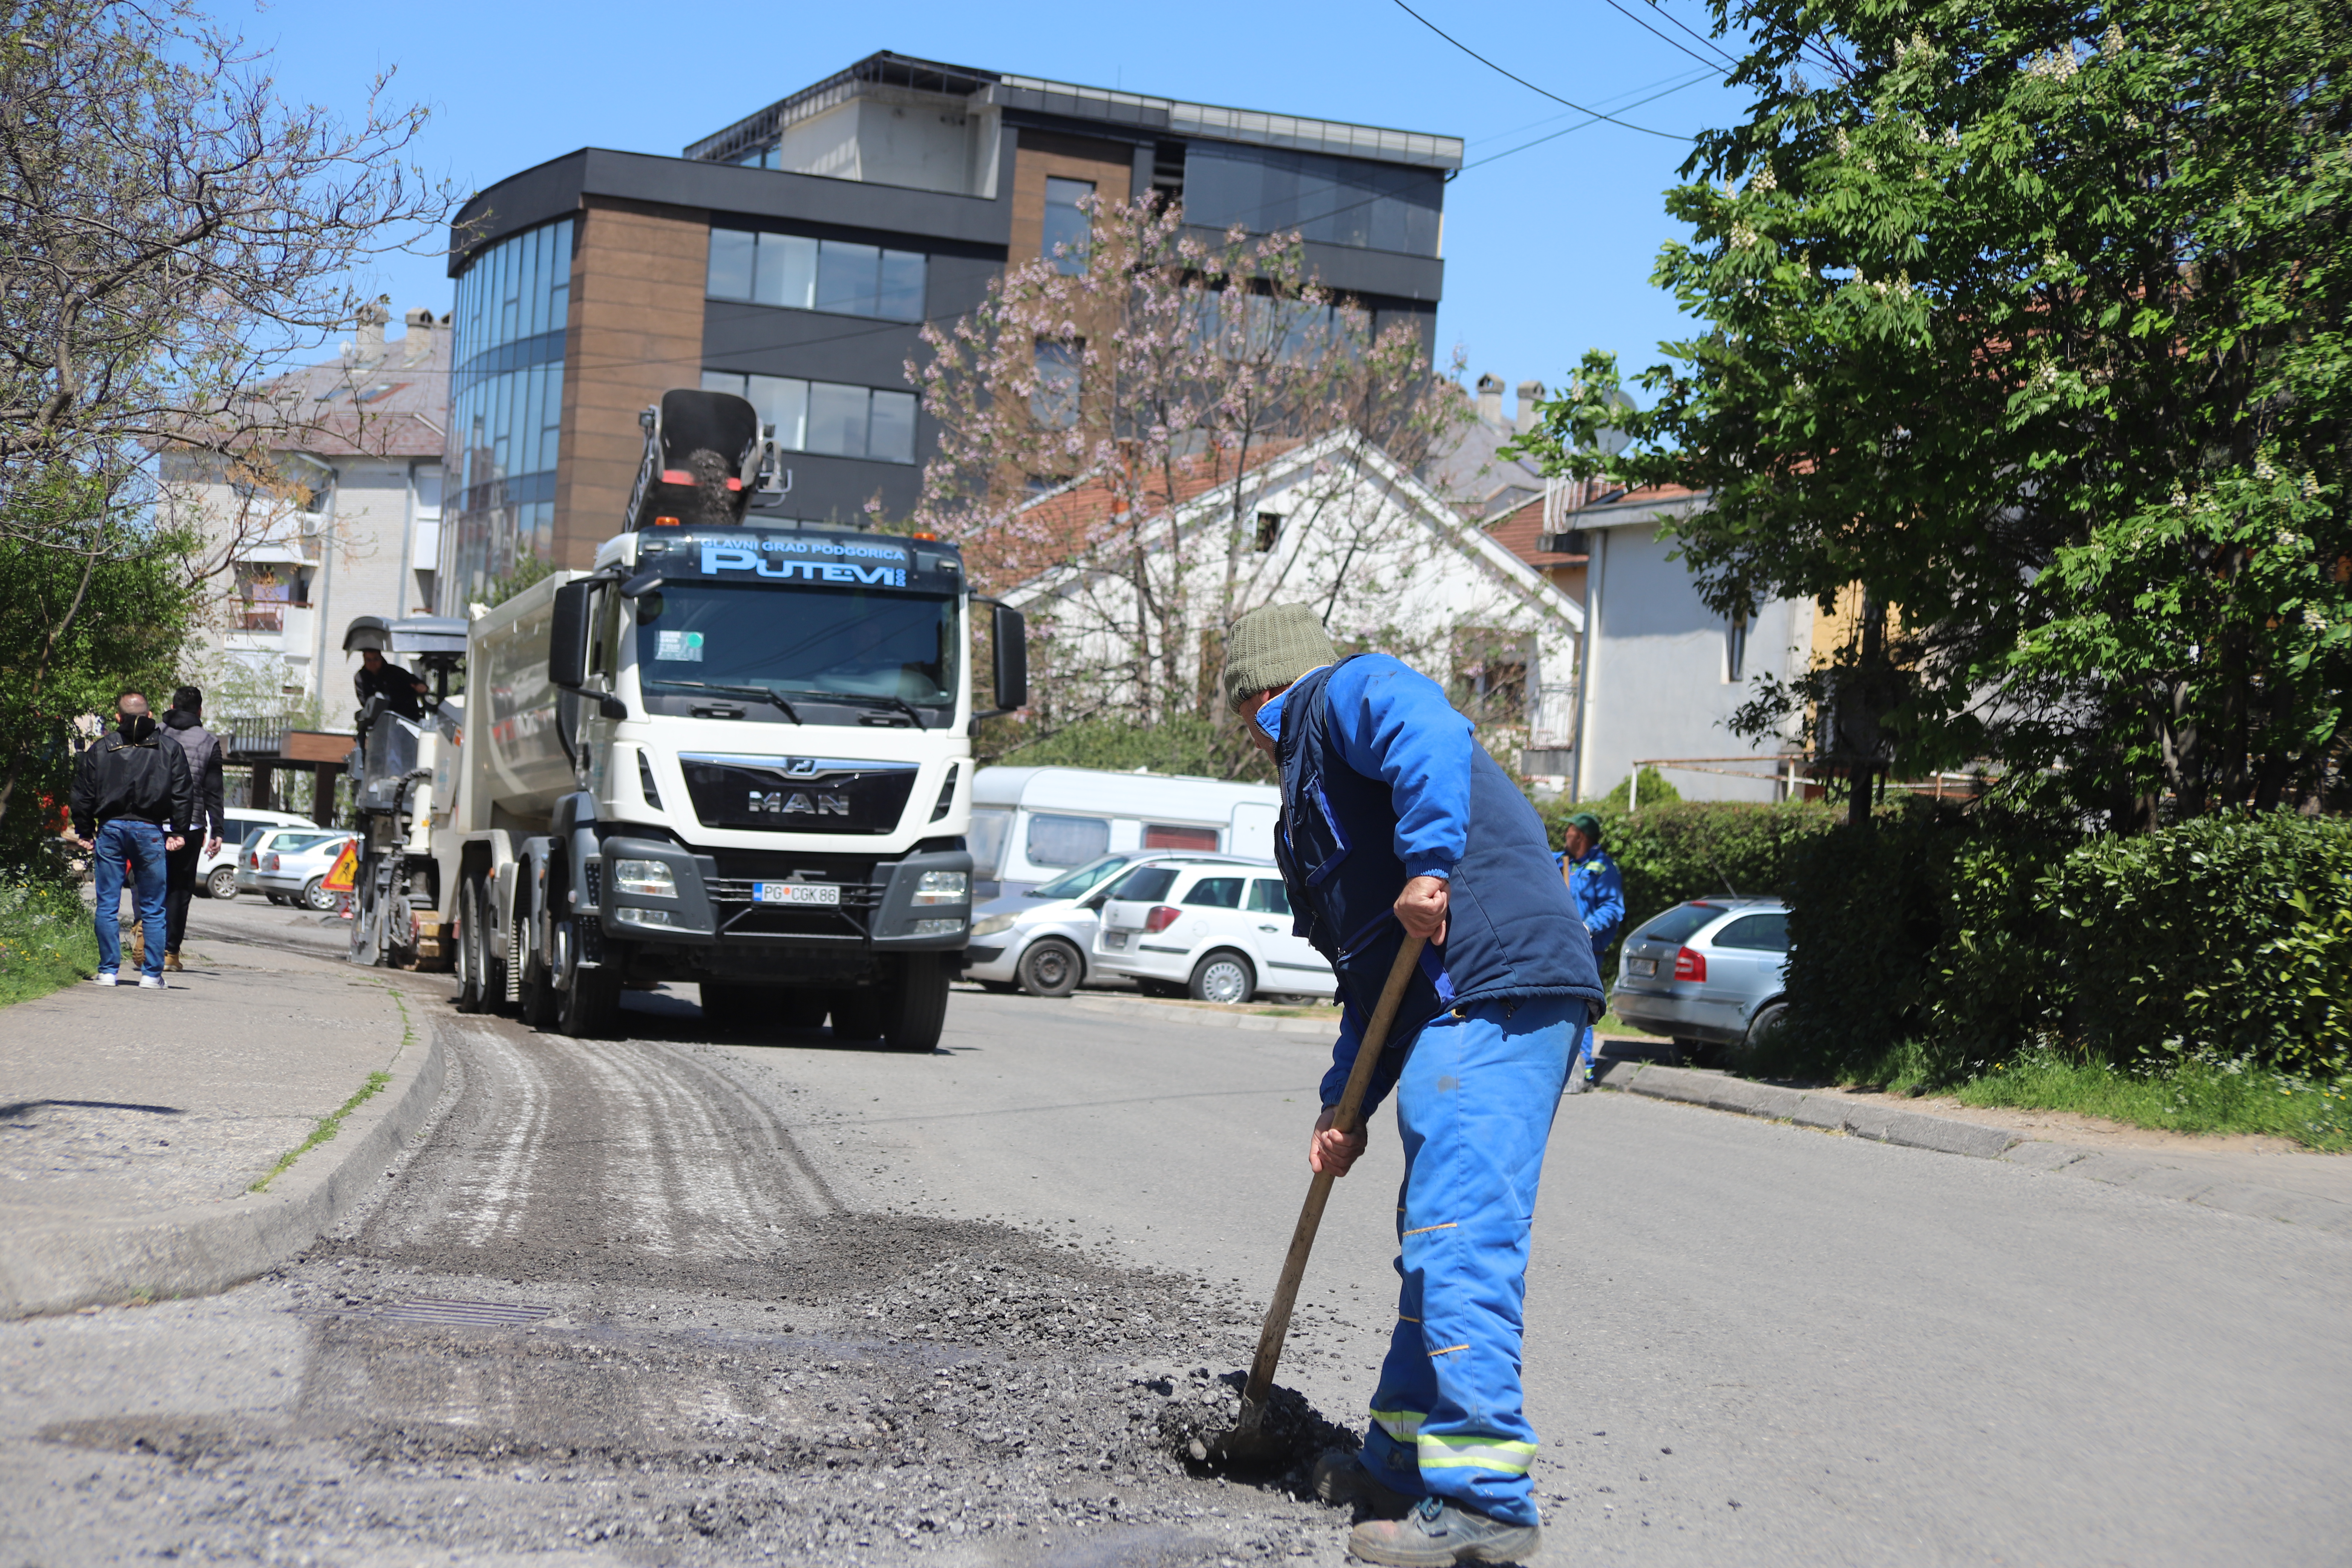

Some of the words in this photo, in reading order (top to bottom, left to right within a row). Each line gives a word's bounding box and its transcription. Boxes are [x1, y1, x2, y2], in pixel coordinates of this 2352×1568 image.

[700, 538, 758, 550] GLAVNI
[762, 541, 807, 553] GRAD
[811, 544, 905, 561] PODGORICA
[749, 791, 849, 815] MAN
[764, 886, 782, 899] PG
